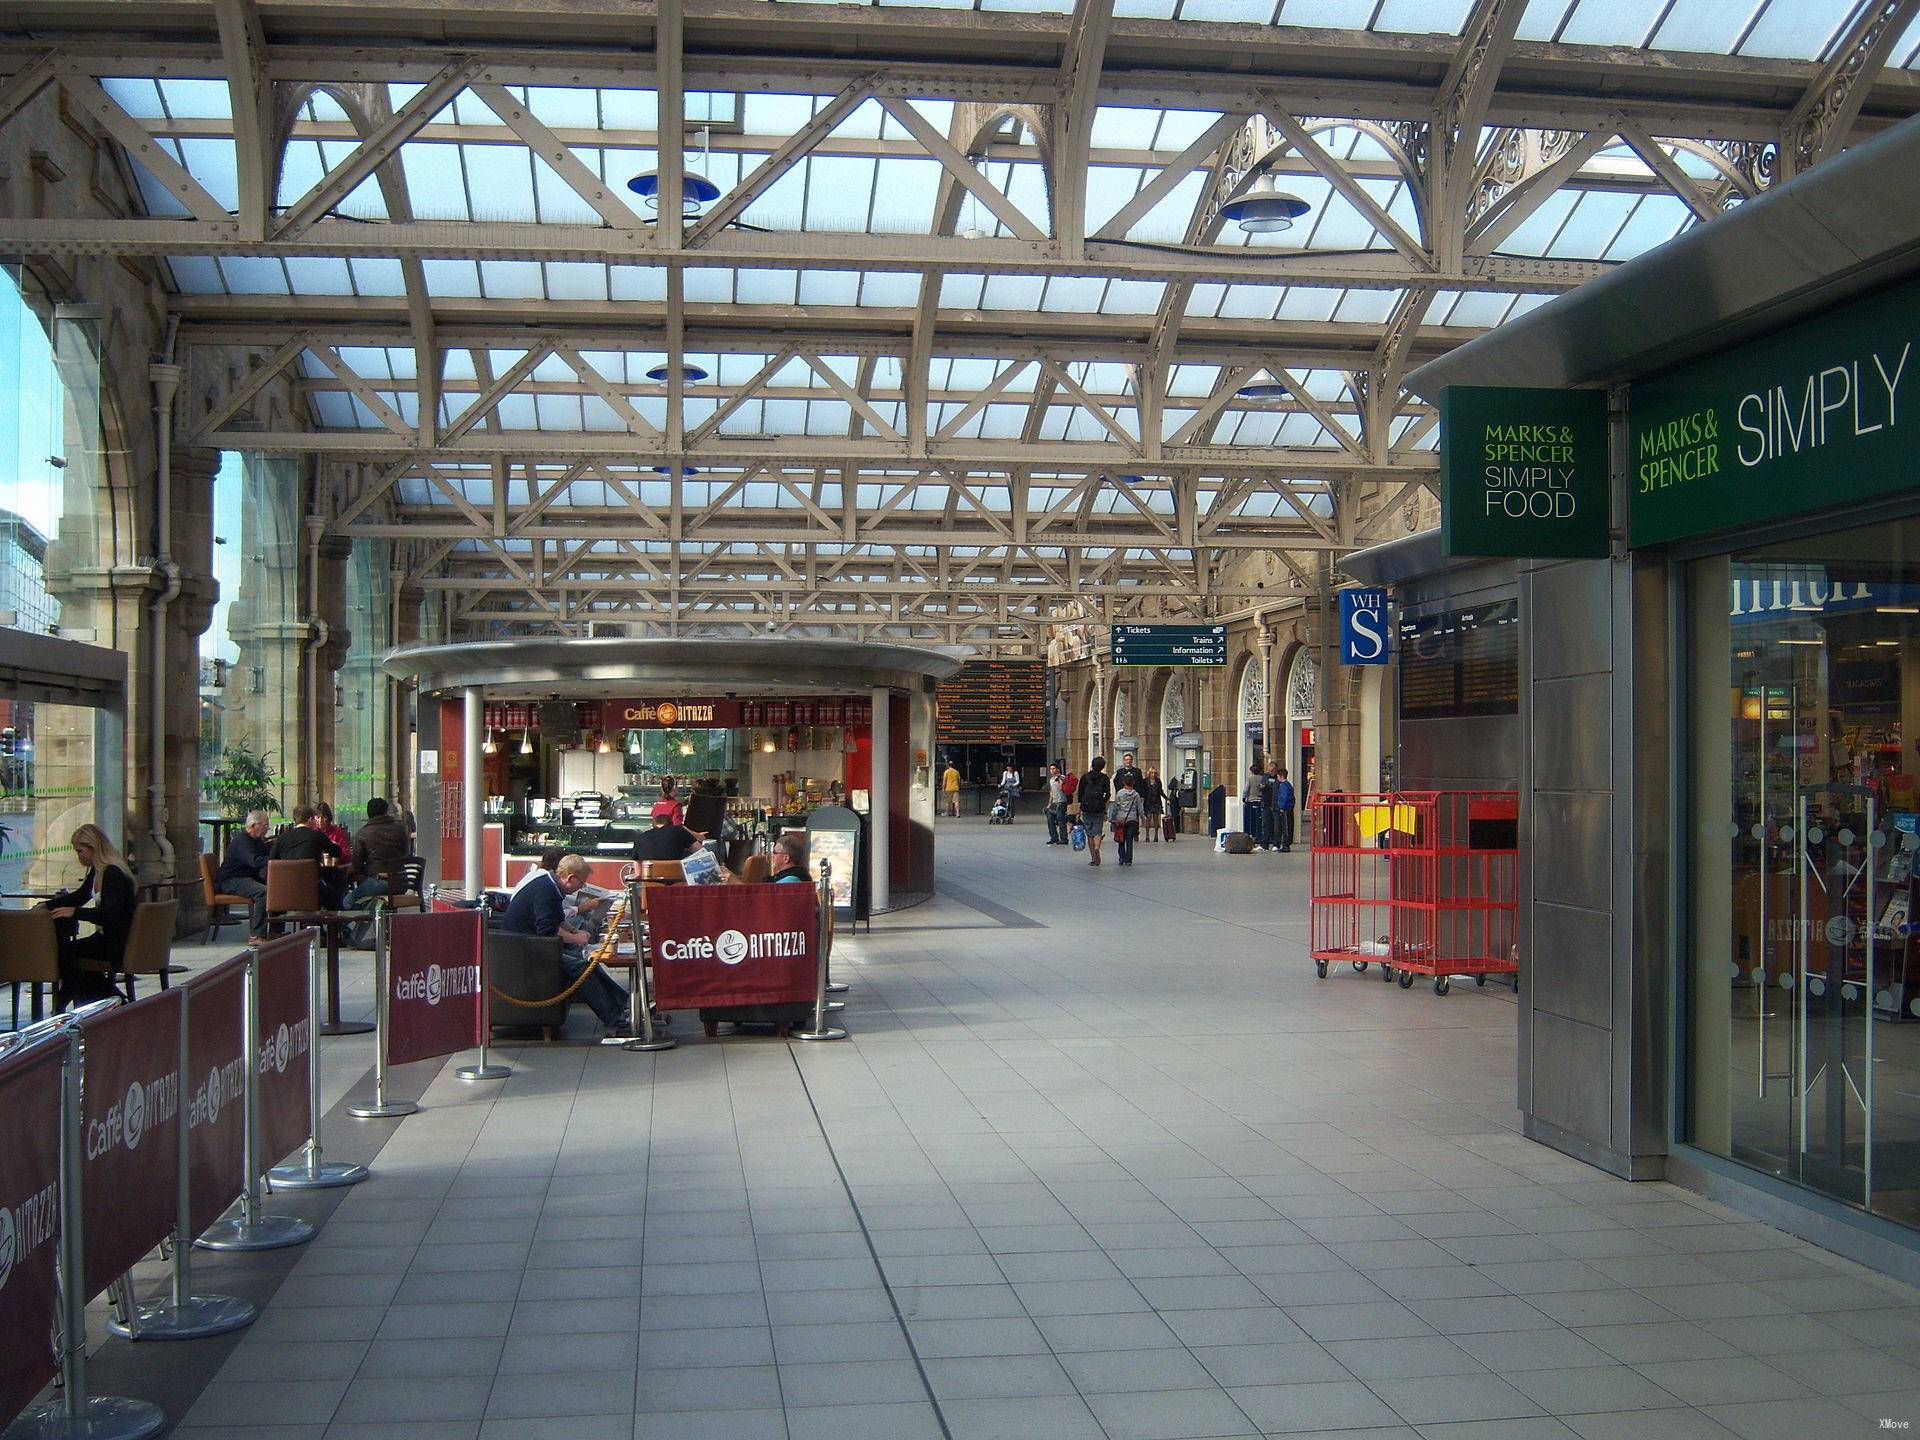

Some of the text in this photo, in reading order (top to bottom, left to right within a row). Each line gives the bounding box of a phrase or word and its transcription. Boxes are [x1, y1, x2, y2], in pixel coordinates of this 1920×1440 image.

[1738, 342, 1911, 466] SIMPLY
[1485, 424, 1557, 443] MARKS
[1485, 444, 1576, 463] SPENCER
[1485, 466, 1575, 489] SIMPLY
[1640, 444, 1720, 493] SPENCER
[1486, 490, 1576, 518] FOOD
[1351, 594, 1381, 608] WH
[1126, 626, 1151, 634] Tickets
[1192, 636, 1213, 644] Trains
[1351, 608, 1383, 659] S
[1172, 646, 1214, 654] Information
[1190, 656, 1213, 664] Toilets
[624, 705, 713, 722] Caffè RITAZZA
[661, 931, 806, 961] Caffè RITAZZA
[258, 1035, 274, 1074] affè
[188, 1082, 207, 1129] affè
[87, 1099, 122, 1161] Caffè
